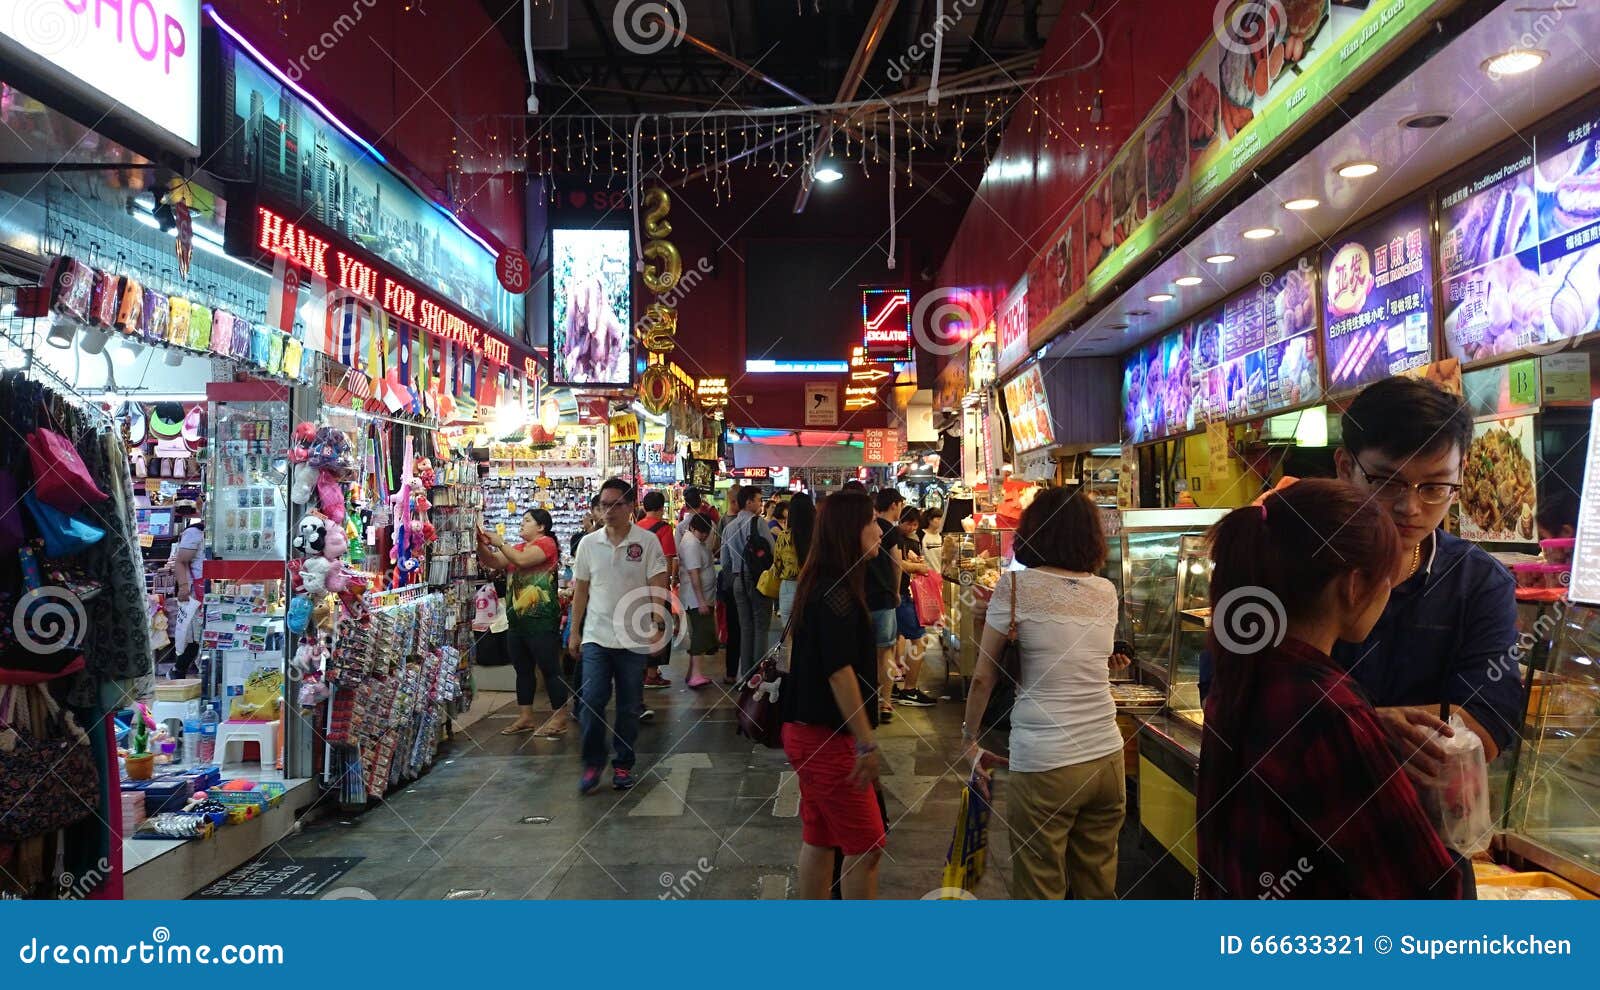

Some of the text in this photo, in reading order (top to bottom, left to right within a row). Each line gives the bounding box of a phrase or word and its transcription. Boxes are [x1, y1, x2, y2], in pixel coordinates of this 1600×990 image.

[63, 0, 187, 75] HOP
[1473, 155, 1532, 193] Traditional Pancake
[504, 255, 523, 272] SG
[259, 207, 330, 278] HANK
[336, 252, 378, 301] YOU
[383, 277, 415, 323] FOR
[420, 299, 480, 350] SHOPPING
[483, 333, 510, 365] WITH
[504, 272, 523, 288] 50
[866, 330, 908, 341] ESCALATOR
[1516, 370, 1528, 393] B
[744, 468, 767, 477] MORE
